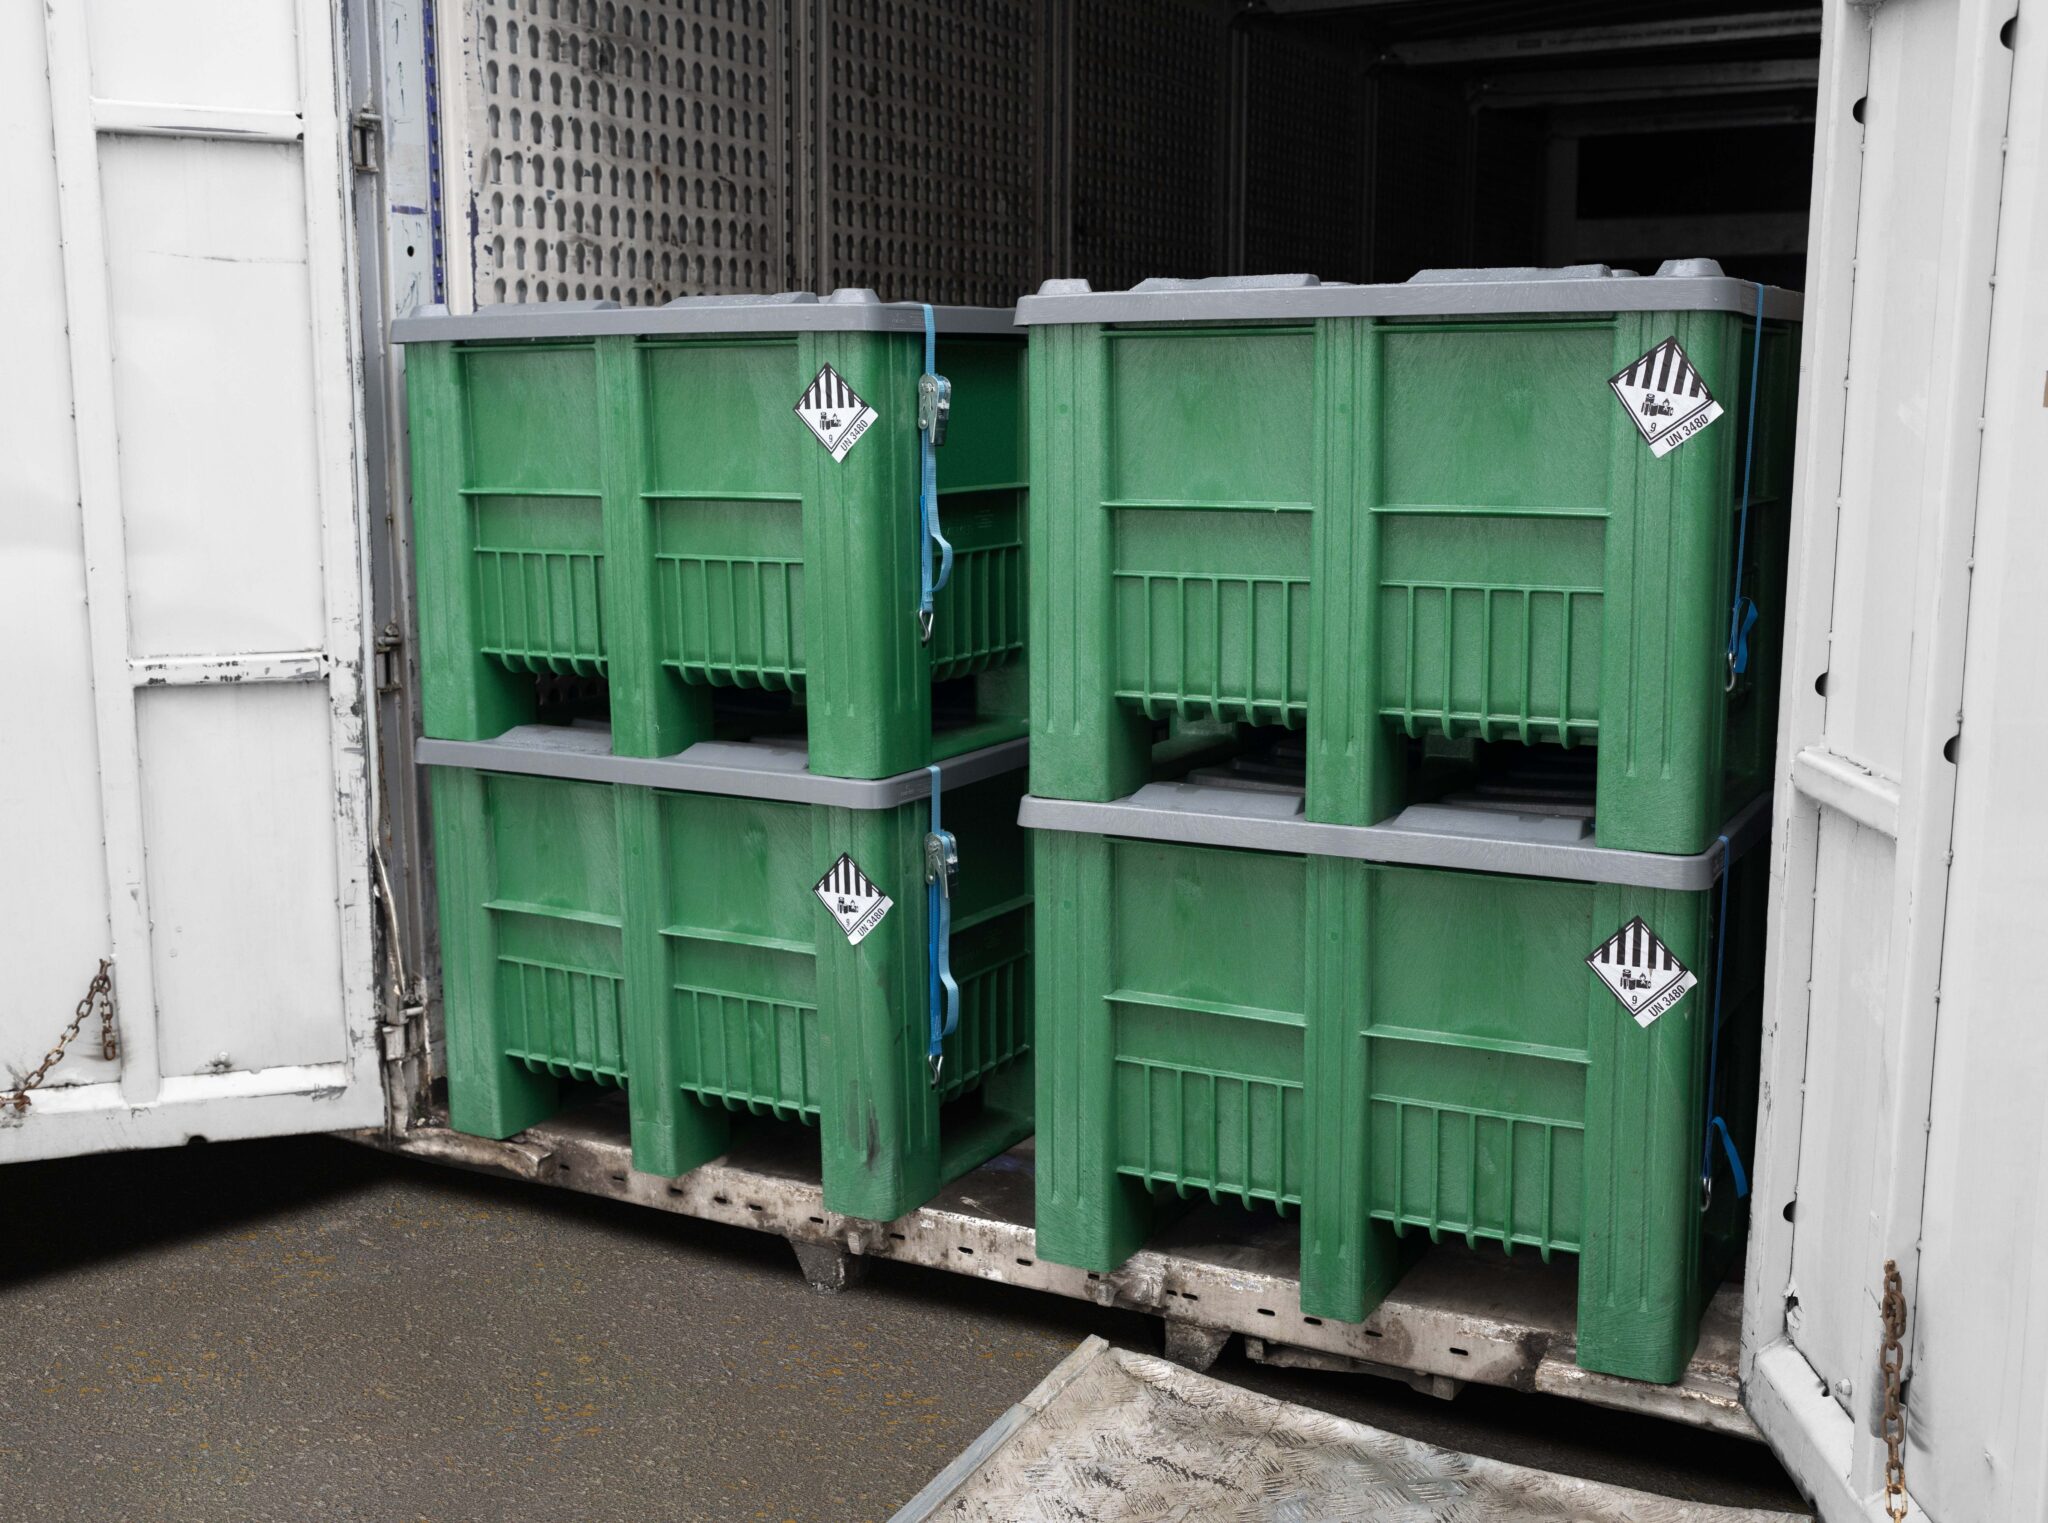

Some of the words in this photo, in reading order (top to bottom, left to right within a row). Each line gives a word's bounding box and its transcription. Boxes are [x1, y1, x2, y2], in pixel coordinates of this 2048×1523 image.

[840, 438, 852, 451] UN
[850, 419, 868, 440] 3480
[1650, 422, 1656, 433] 9
[1666, 431, 1683, 447] UN
[1682, 414, 1709, 436] 3480
[857, 924, 869, 937] UN
[866, 908, 885, 927] 3480
[1632, 995, 1638, 1005] 9
[1648, 1002, 1665, 1017] UN
[1662, 985, 1686, 1006] 3480
